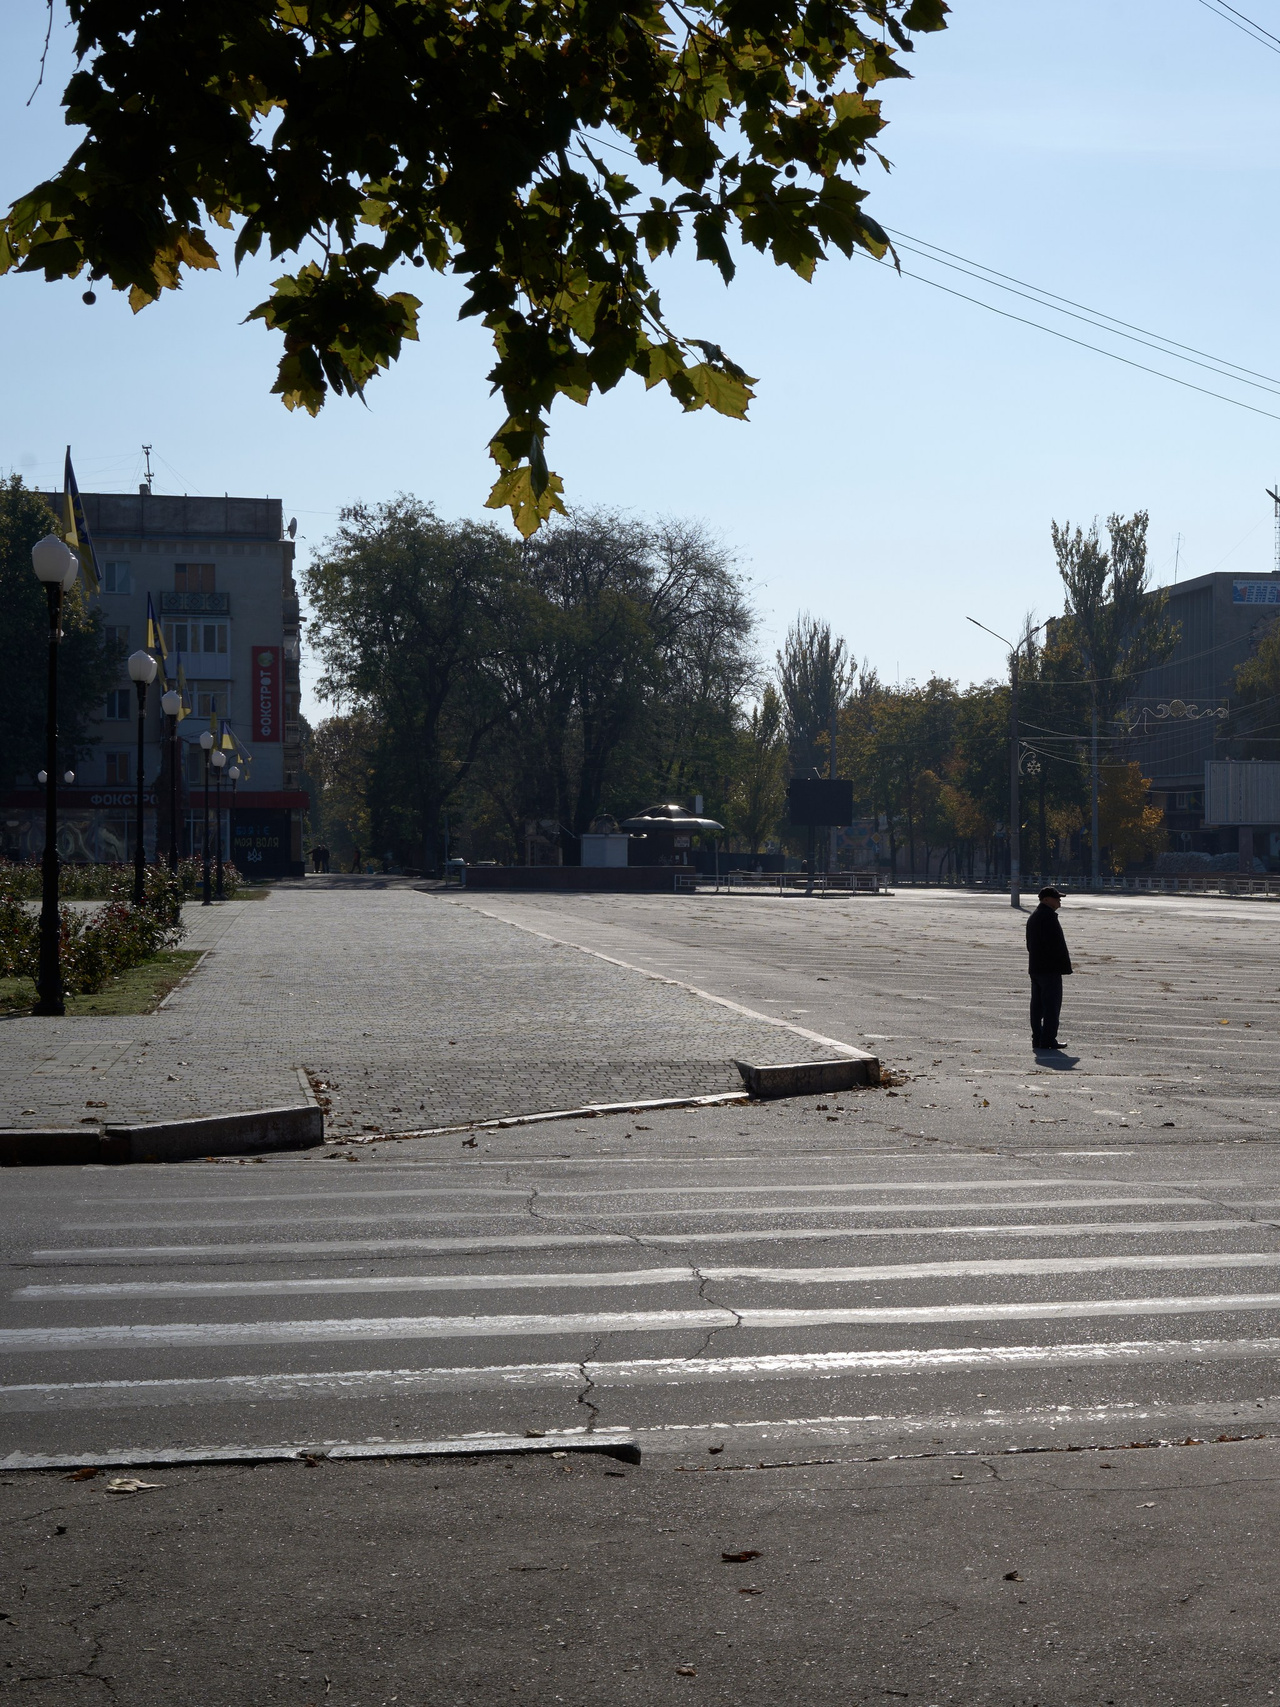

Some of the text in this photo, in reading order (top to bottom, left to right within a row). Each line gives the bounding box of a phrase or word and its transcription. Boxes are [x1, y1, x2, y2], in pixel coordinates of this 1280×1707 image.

[1246, 585, 1277, 603] EMS
[259, 669, 272, 737] ФОКСТРОТ
[90, 794, 159, 806] ФОКСТРО
[234, 836, 280, 849] МОЯ ВОЛЯ
